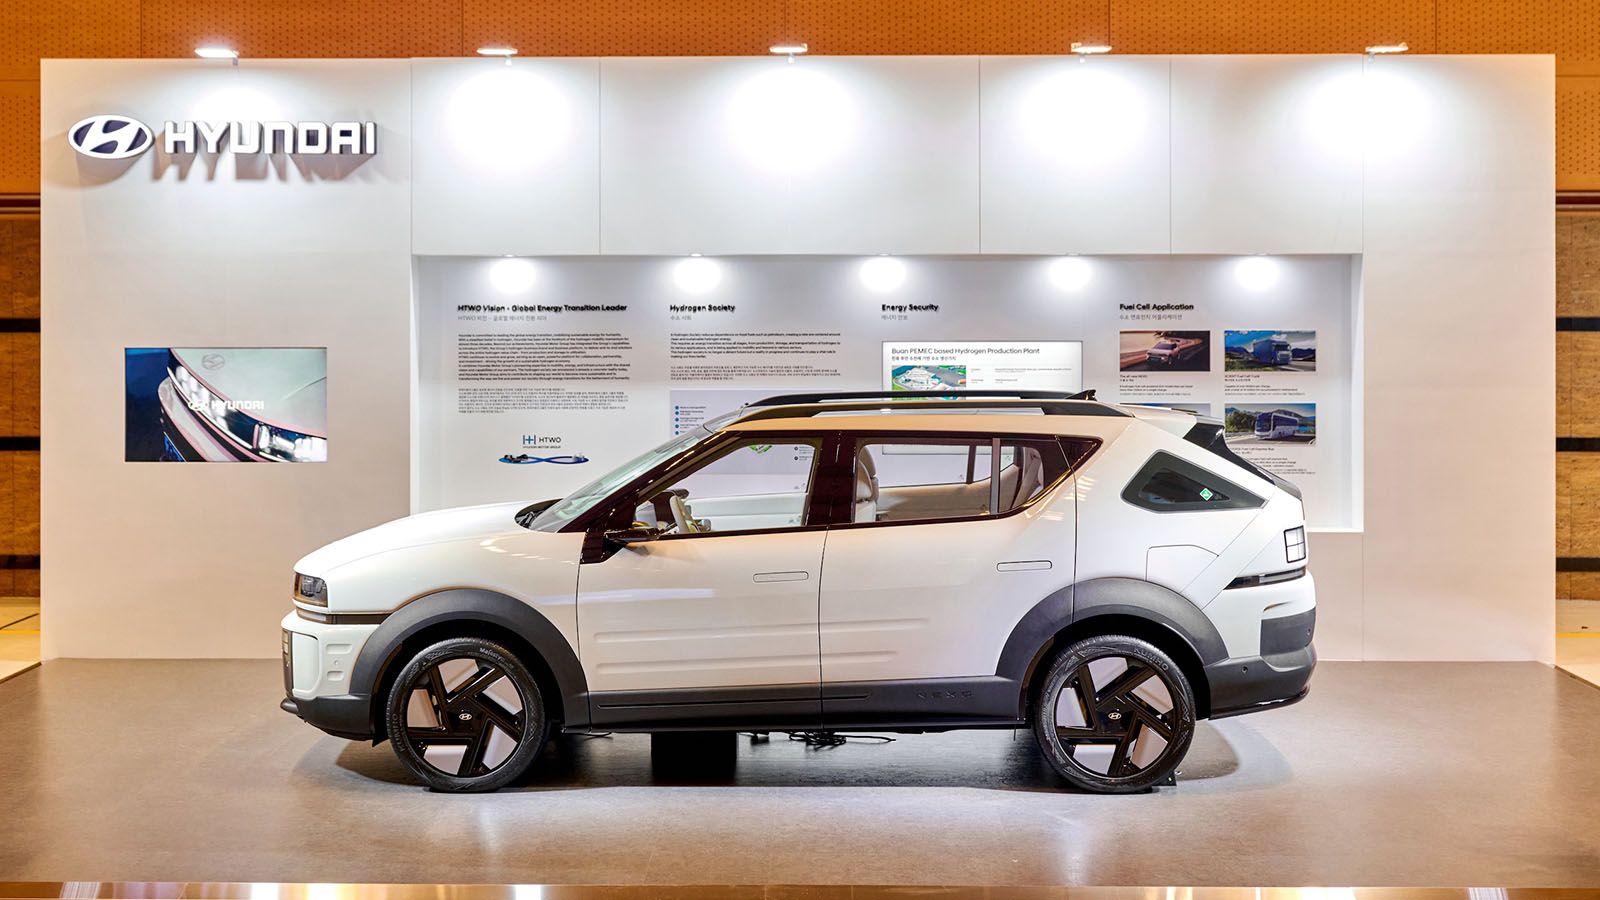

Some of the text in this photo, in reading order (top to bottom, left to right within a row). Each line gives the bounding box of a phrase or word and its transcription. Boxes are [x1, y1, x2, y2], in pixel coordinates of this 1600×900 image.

[163, 120, 377, 154] HYUNDAI
[457, 304, 482, 312] HTWO
[483, 304, 506, 312] Vision
[511, 304, 536, 312] Global
[537, 304, 562, 313] Energy
[564, 304, 601, 312] Transition
[602, 304, 628, 312] Leader
[670, 304, 736, 313] Hydrogen Society
[881, 303, 939, 313] Energy Security
[1152, 303, 1195, 312] Application
[955, 347, 986, 356] Hydrogen
[211, 399, 264, 410] HYUNDAI
